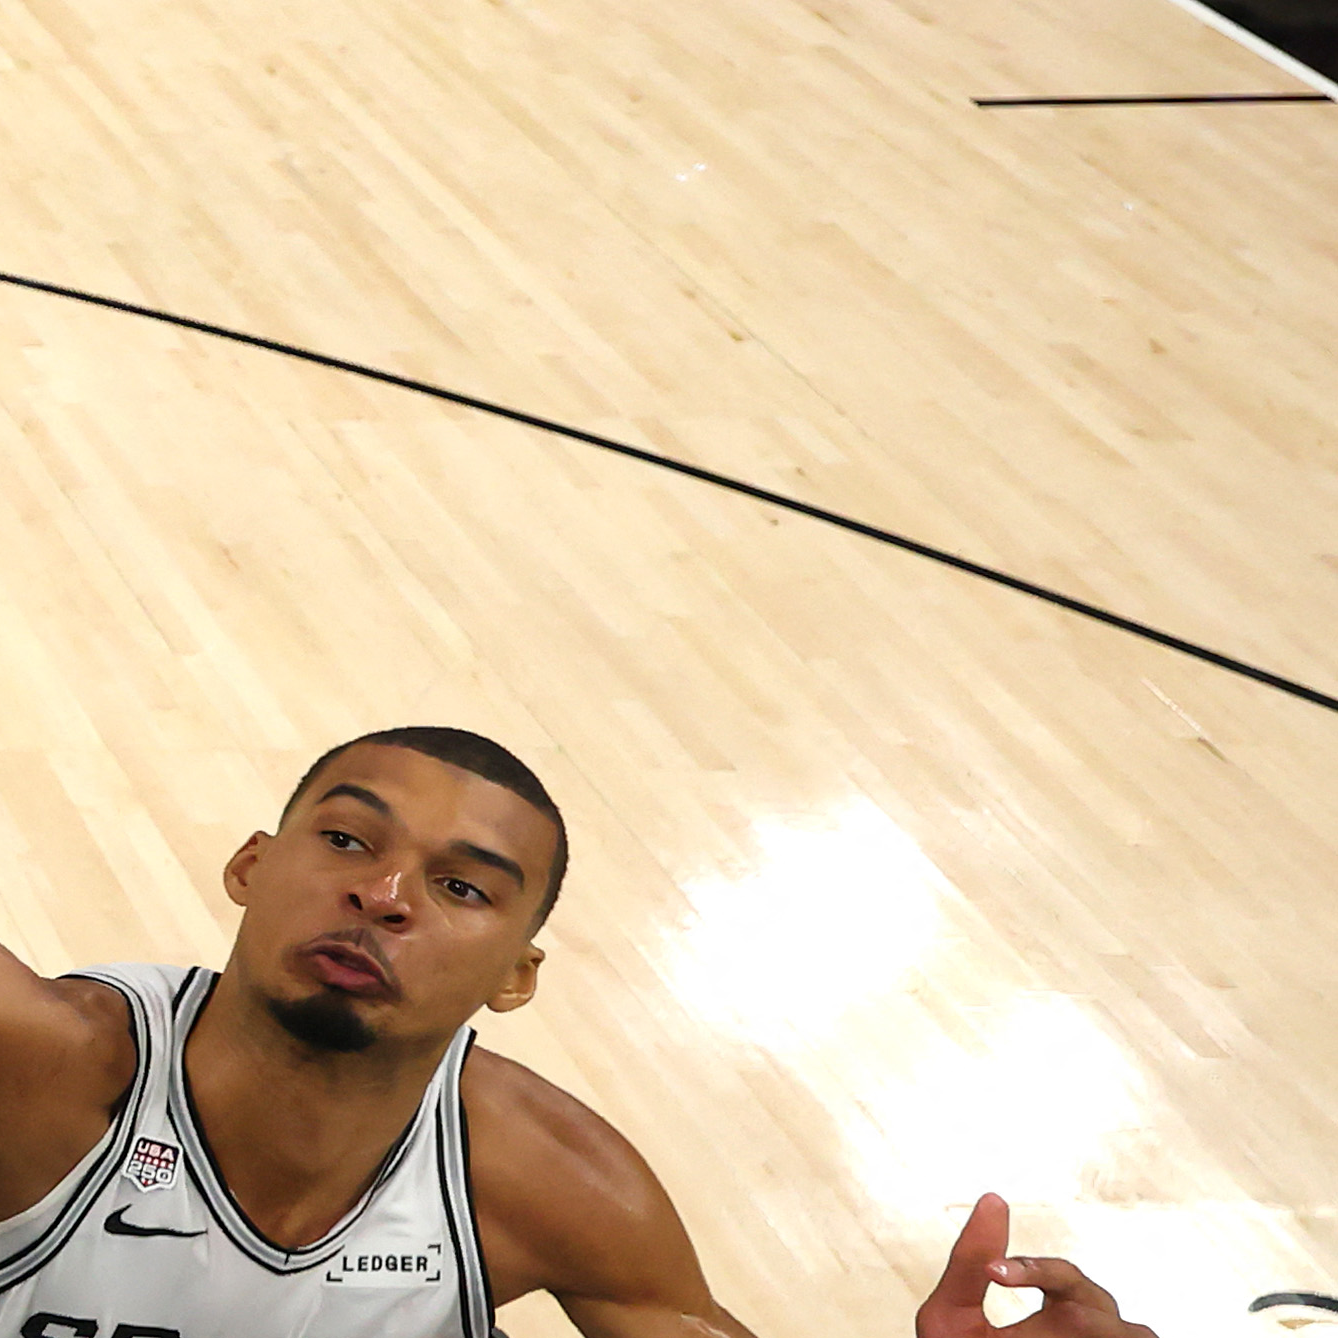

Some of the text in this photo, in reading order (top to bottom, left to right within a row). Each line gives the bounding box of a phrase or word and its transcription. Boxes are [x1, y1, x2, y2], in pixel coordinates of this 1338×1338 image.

[137, 1140, 175, 1163] USA
[127, 1160, 173, 1184] 250
[342, 1255, 428, 1272] LEDGER
